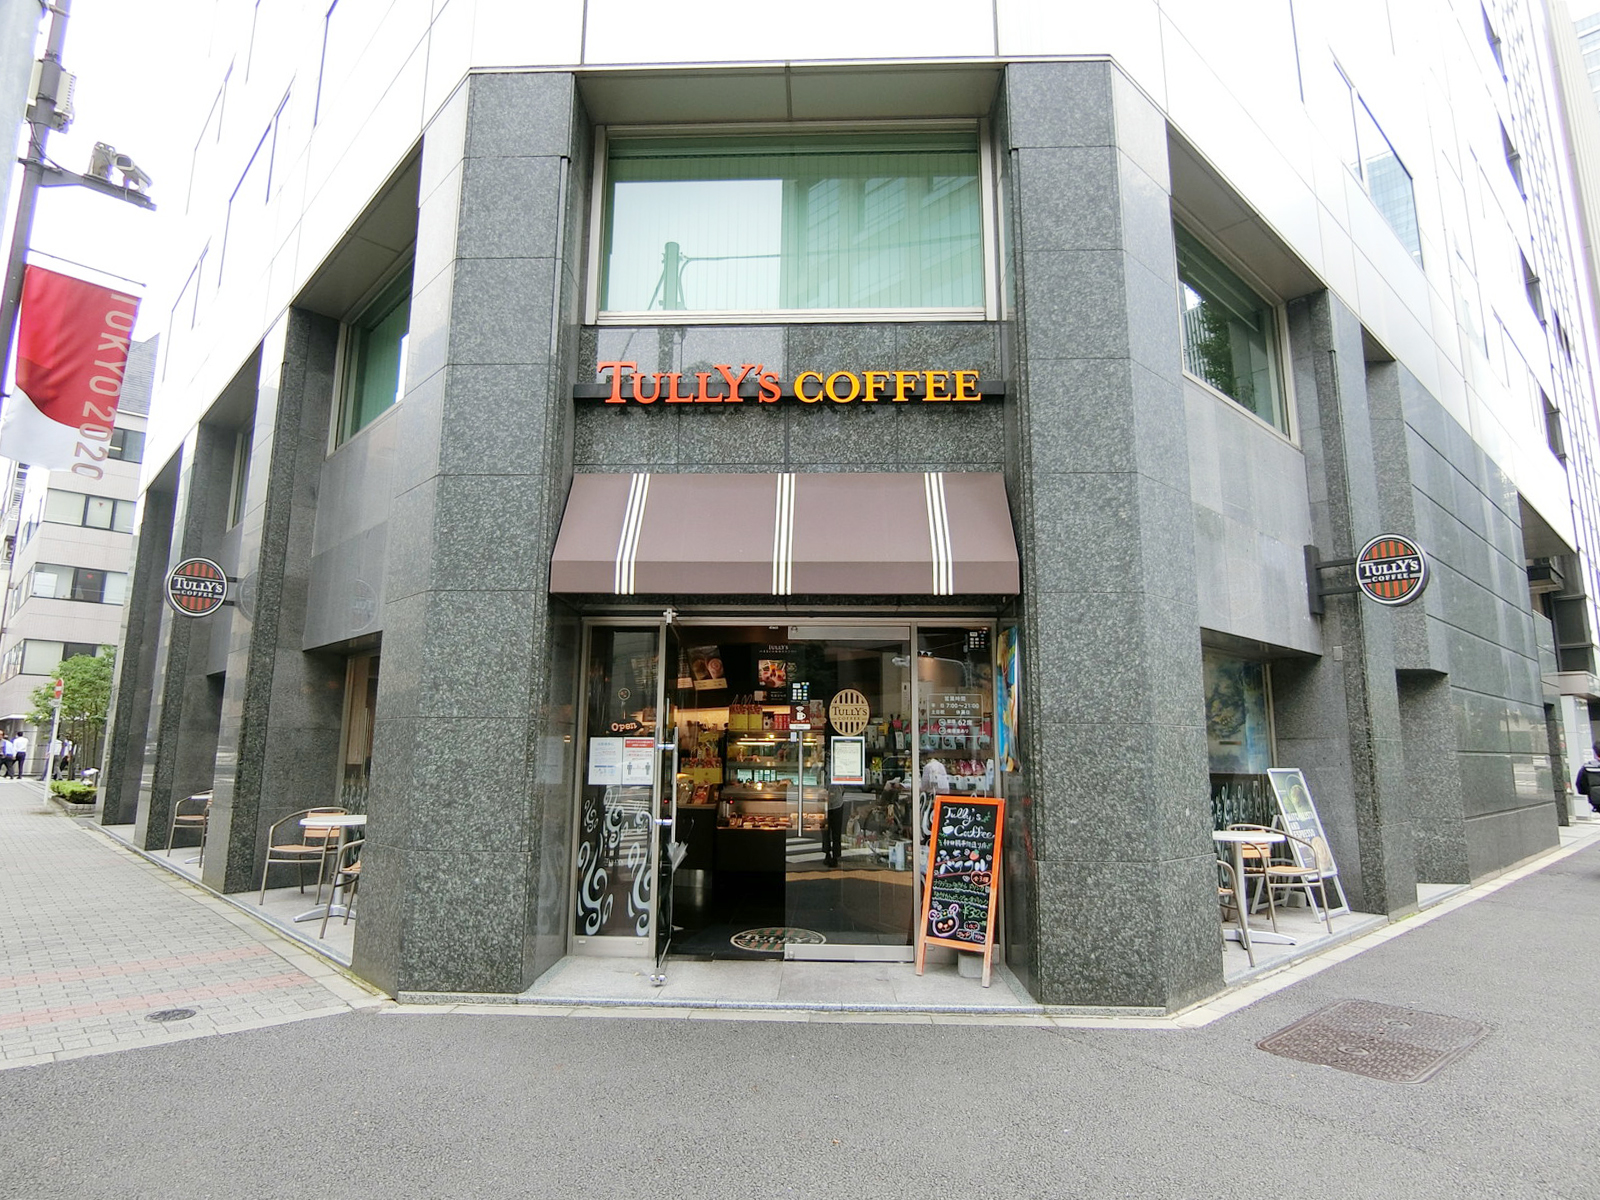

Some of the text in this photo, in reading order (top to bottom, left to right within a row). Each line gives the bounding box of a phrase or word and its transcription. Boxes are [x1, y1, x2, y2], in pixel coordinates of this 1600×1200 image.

[597, 361, 982, 403] TULLY'S COFFEE
[71, 401, 117, 481] 2020
[1360, 559, 1419, 577] TULLY'S
[1372, 572, 1409, 582] COFFEE
[173, 577, 223, 593] TULLY'S
[181, 590, 214, 598] COFFEE
[831, 706, 868, 716] TULLY'S
[611, 721, 638, 732] Open
[943, 806, 981, 826] Tully's
[963, 904, 987, 919] ¥320
